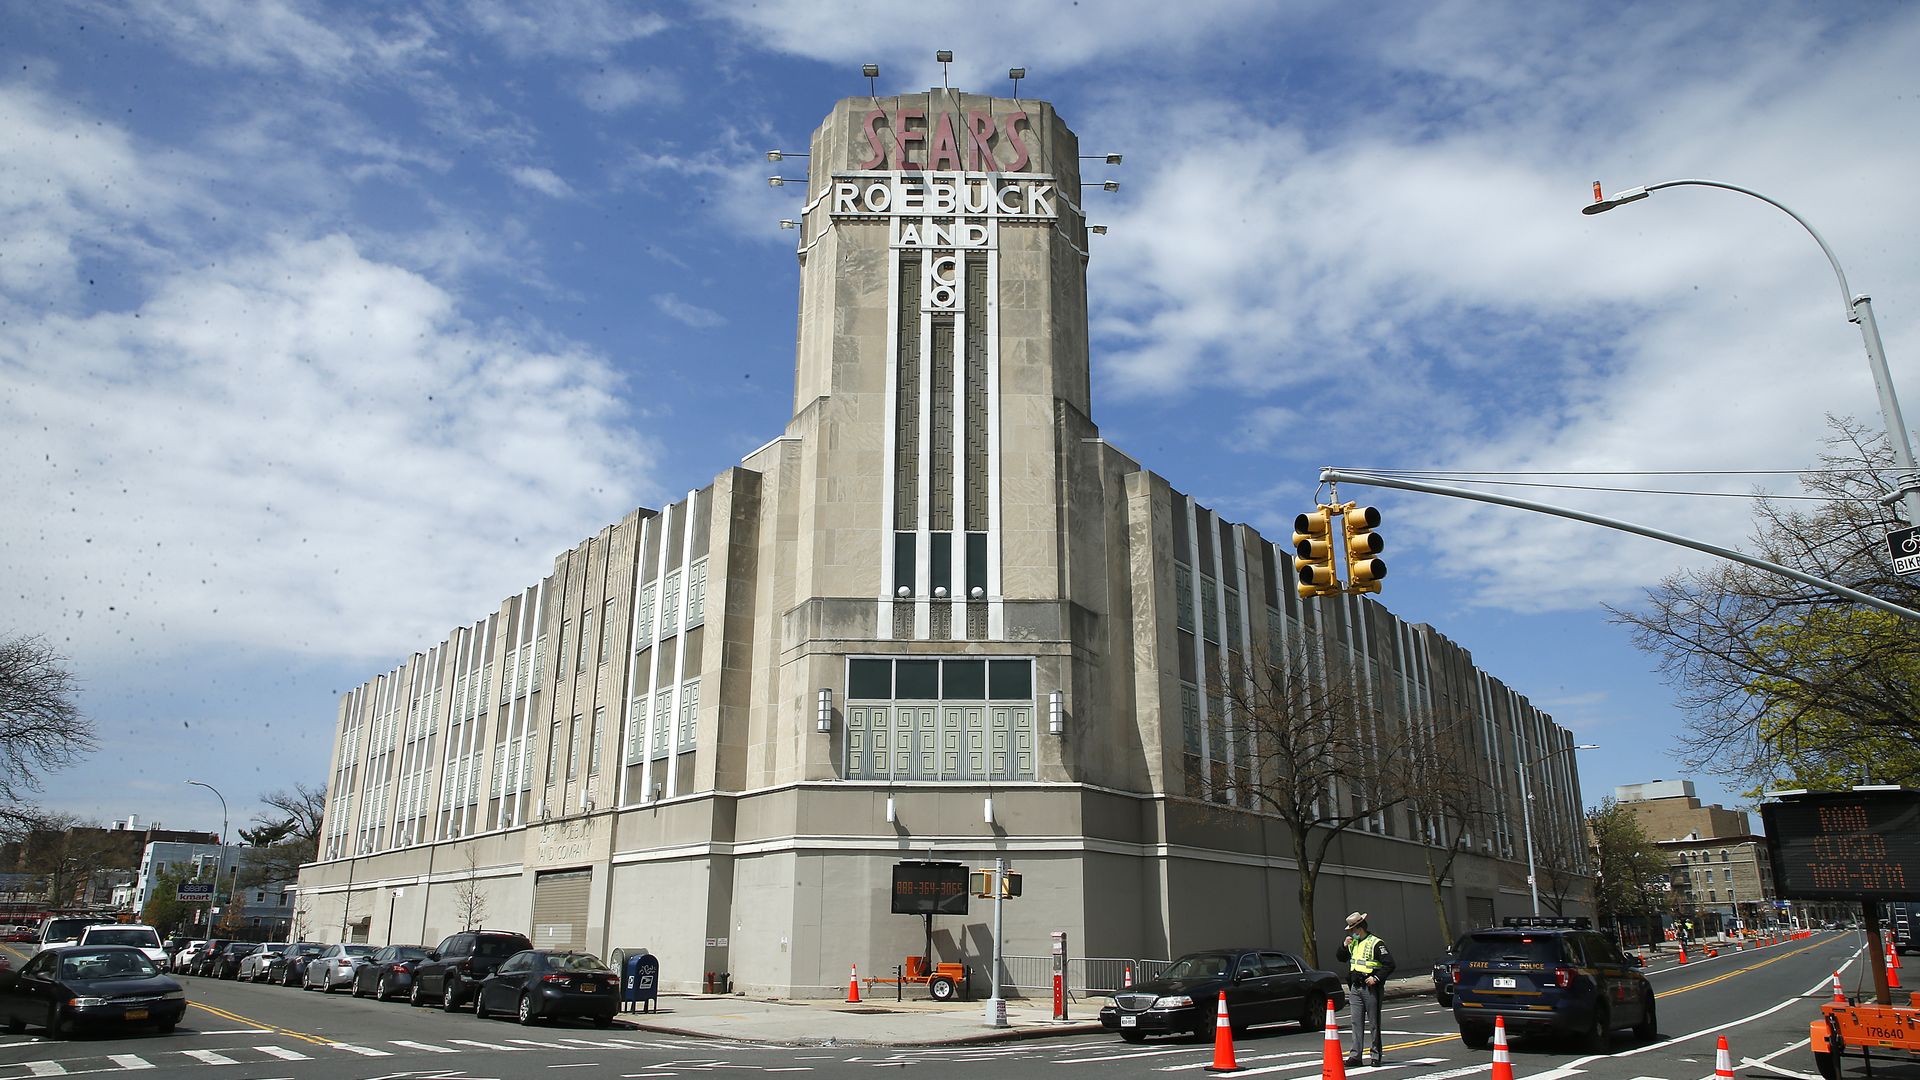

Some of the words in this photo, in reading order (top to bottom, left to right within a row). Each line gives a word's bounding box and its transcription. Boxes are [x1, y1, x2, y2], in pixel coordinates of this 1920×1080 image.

[861, 109, 1029, 171] SEARS
[835, 183, 1054, 215] ROEBUCK
[899, 223, 990, 246] AND
[1819, 805, 1869, 832] ROAD
[1813, 834, 1887, 860] CLOSED
[1866, 1027, 1903, 1039] 178640
